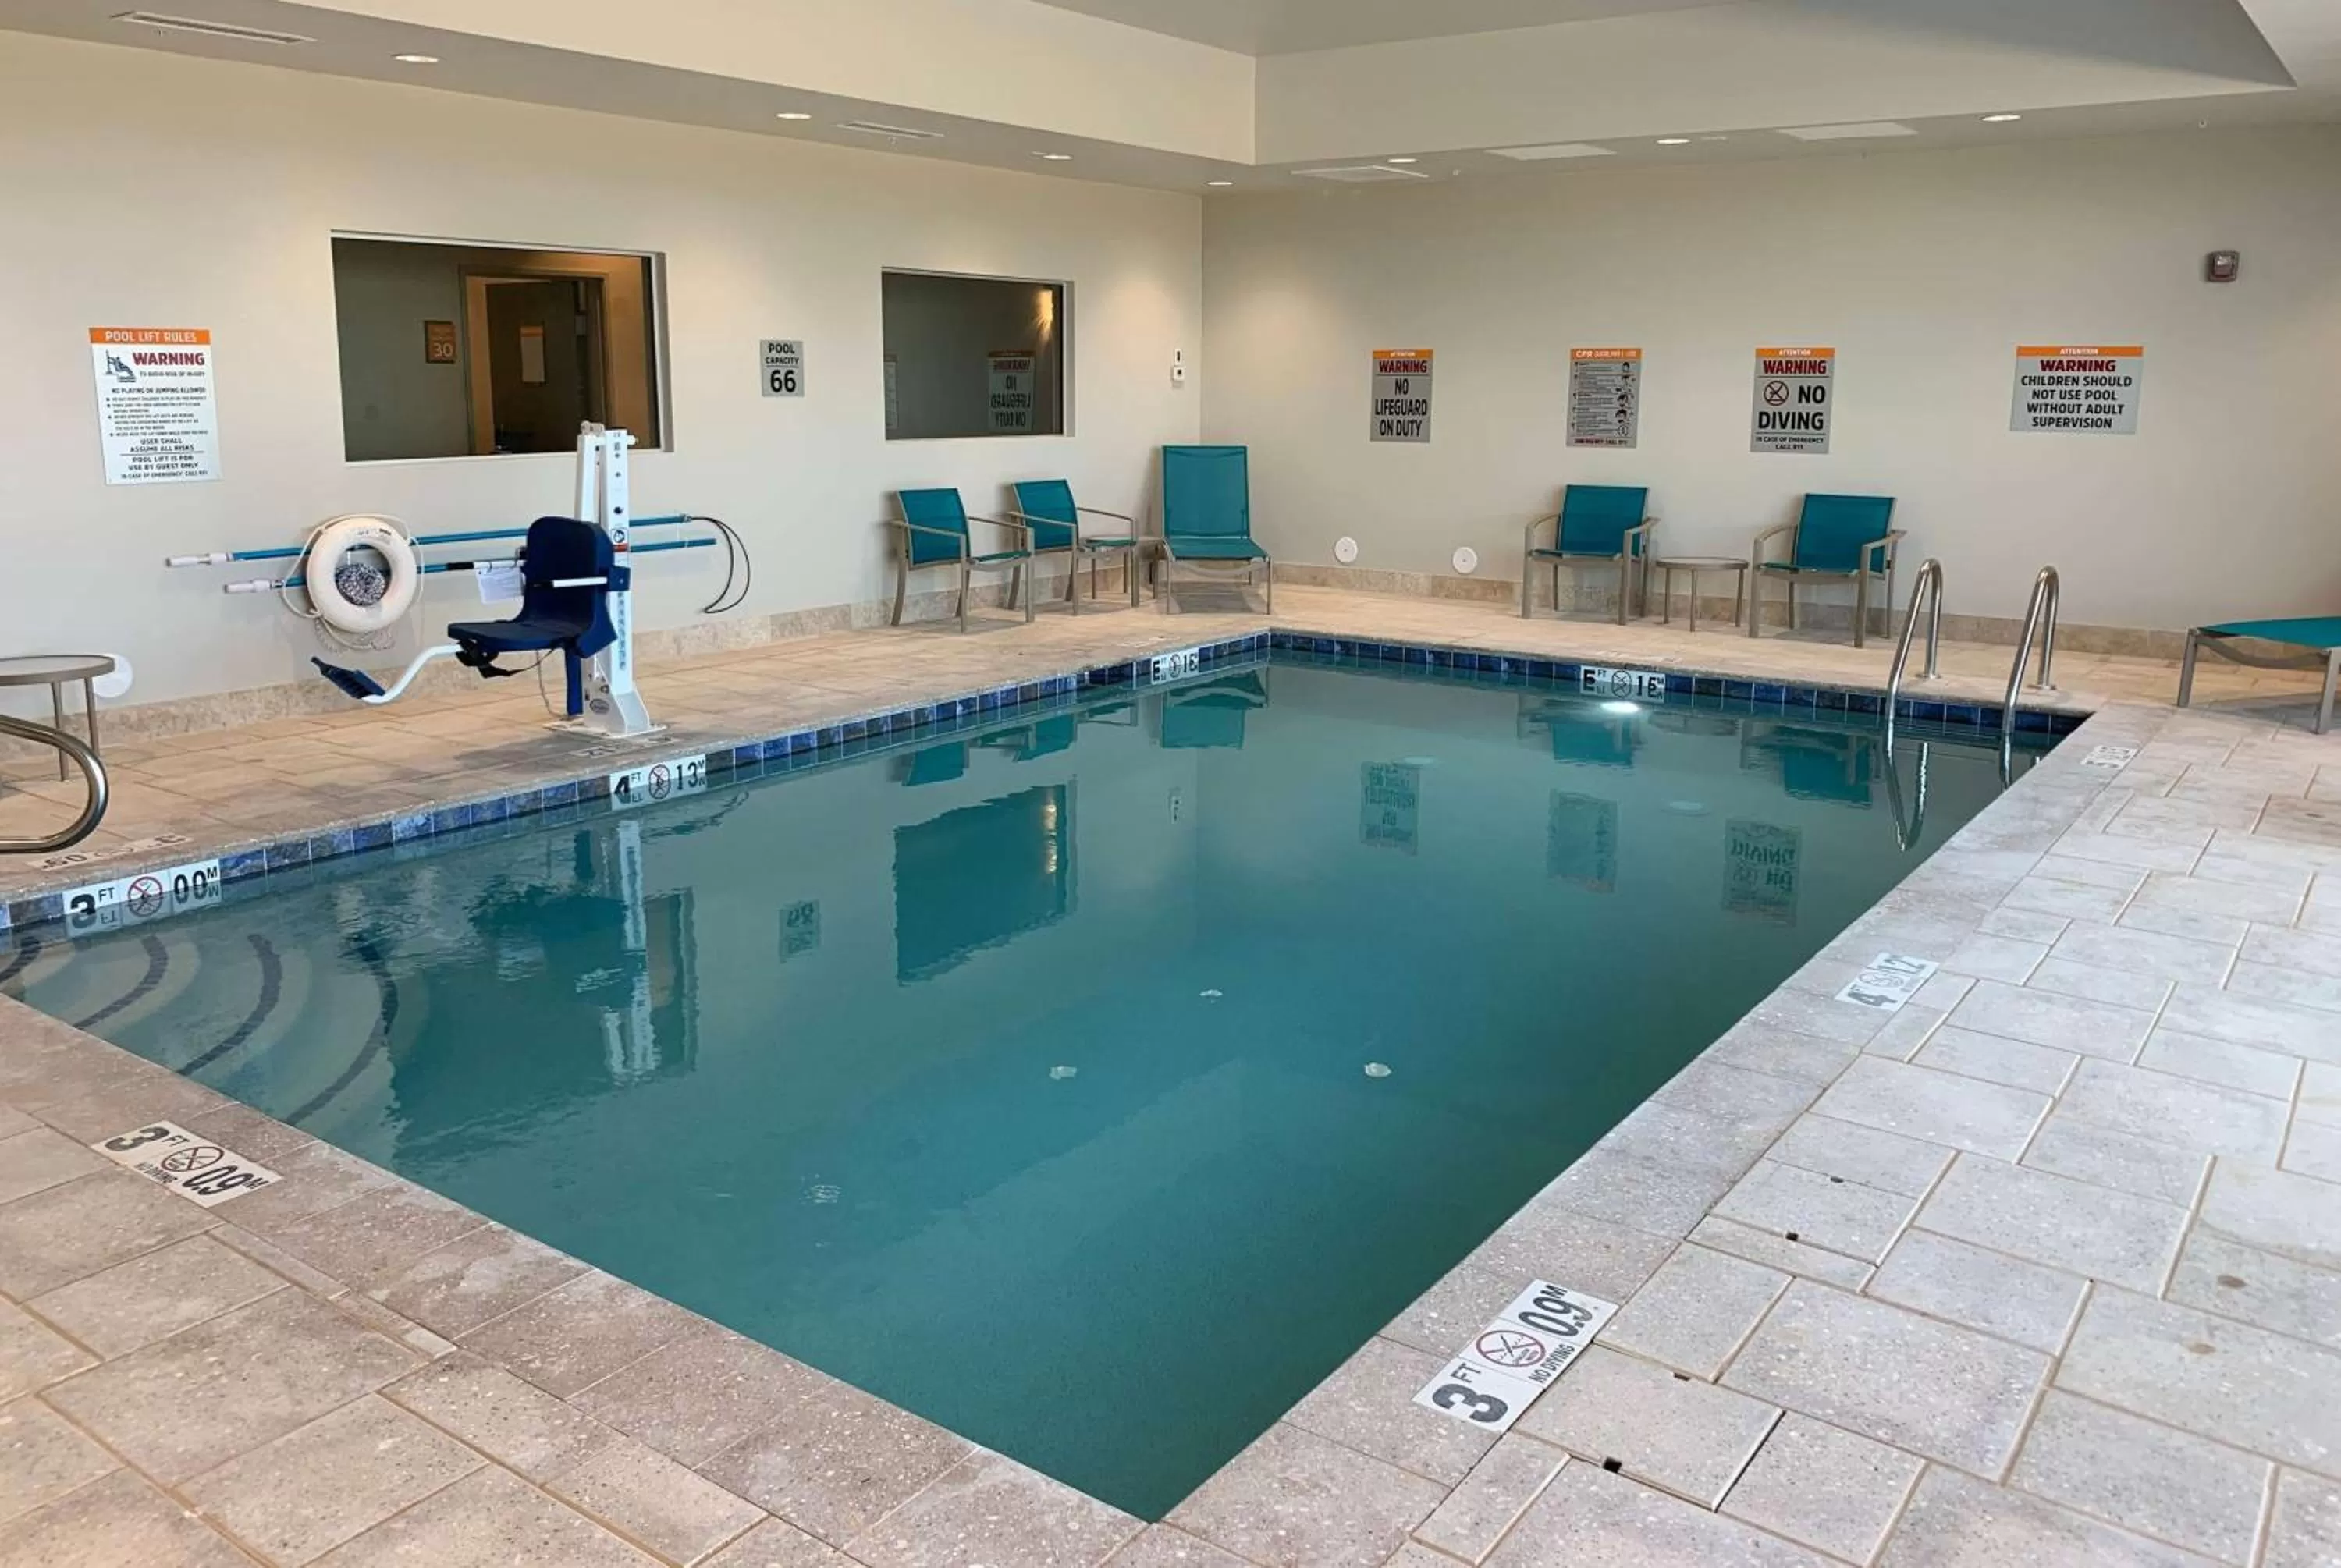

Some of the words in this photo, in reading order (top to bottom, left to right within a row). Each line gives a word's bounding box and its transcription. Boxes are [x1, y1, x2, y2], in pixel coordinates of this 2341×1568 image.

[105, 330, 134, 342] POOL
[140, 331, 161, 342] LIFT
[164, 332, 197, 342] RULES
[433, 342, 454, 357] 30
[769, 342, 795, 354] POOL
[1575, 349, 1593, 358] CPR
[133, 352, 205, 366] WARNING
[766, 356, 800, 364] CAPACITY
[2039, 360, 2116, 372] WARNING
[1379, 360, 1427, 374] WARNING
[1763, 360, 1827, 375] WARNING
[770, 369, 797, 393] 66
[1394, 378, 1409, 396] NO
[2020, 375, 2080, 387] CHILDREN
[2082, 375, 2133, 387] SHOULD
[1797, 385, 1826, 404] NO
[2031, 389, 2056, 400] NOT
[2059, 389, 2082, 400] USE
[2084, 389, 2118, 401] POOL
[1375, 399, 1427, 417] LIFEGUARD
[2027, 402, 2083, 414] WITHOUT
[2084, 403, 2125, 415] ADULT
[1757, 410, 1824, 431] DIVING
[2031, 417, 2112, 429] SUPERVISION
[1379, 419, 1394, 437] ON
[1396, 419, 1423, 438] DUTY
[98, 888, 115, 903] FT
[105, 1126, 170, 1153] 3
[1528, 1368, 1552, 1383] NO
[1540, 1343, 1575, 1372] DIVING
[1449, 1363, 1482, 1384] FT
[1432, 1383, 1508, 1424] 3
